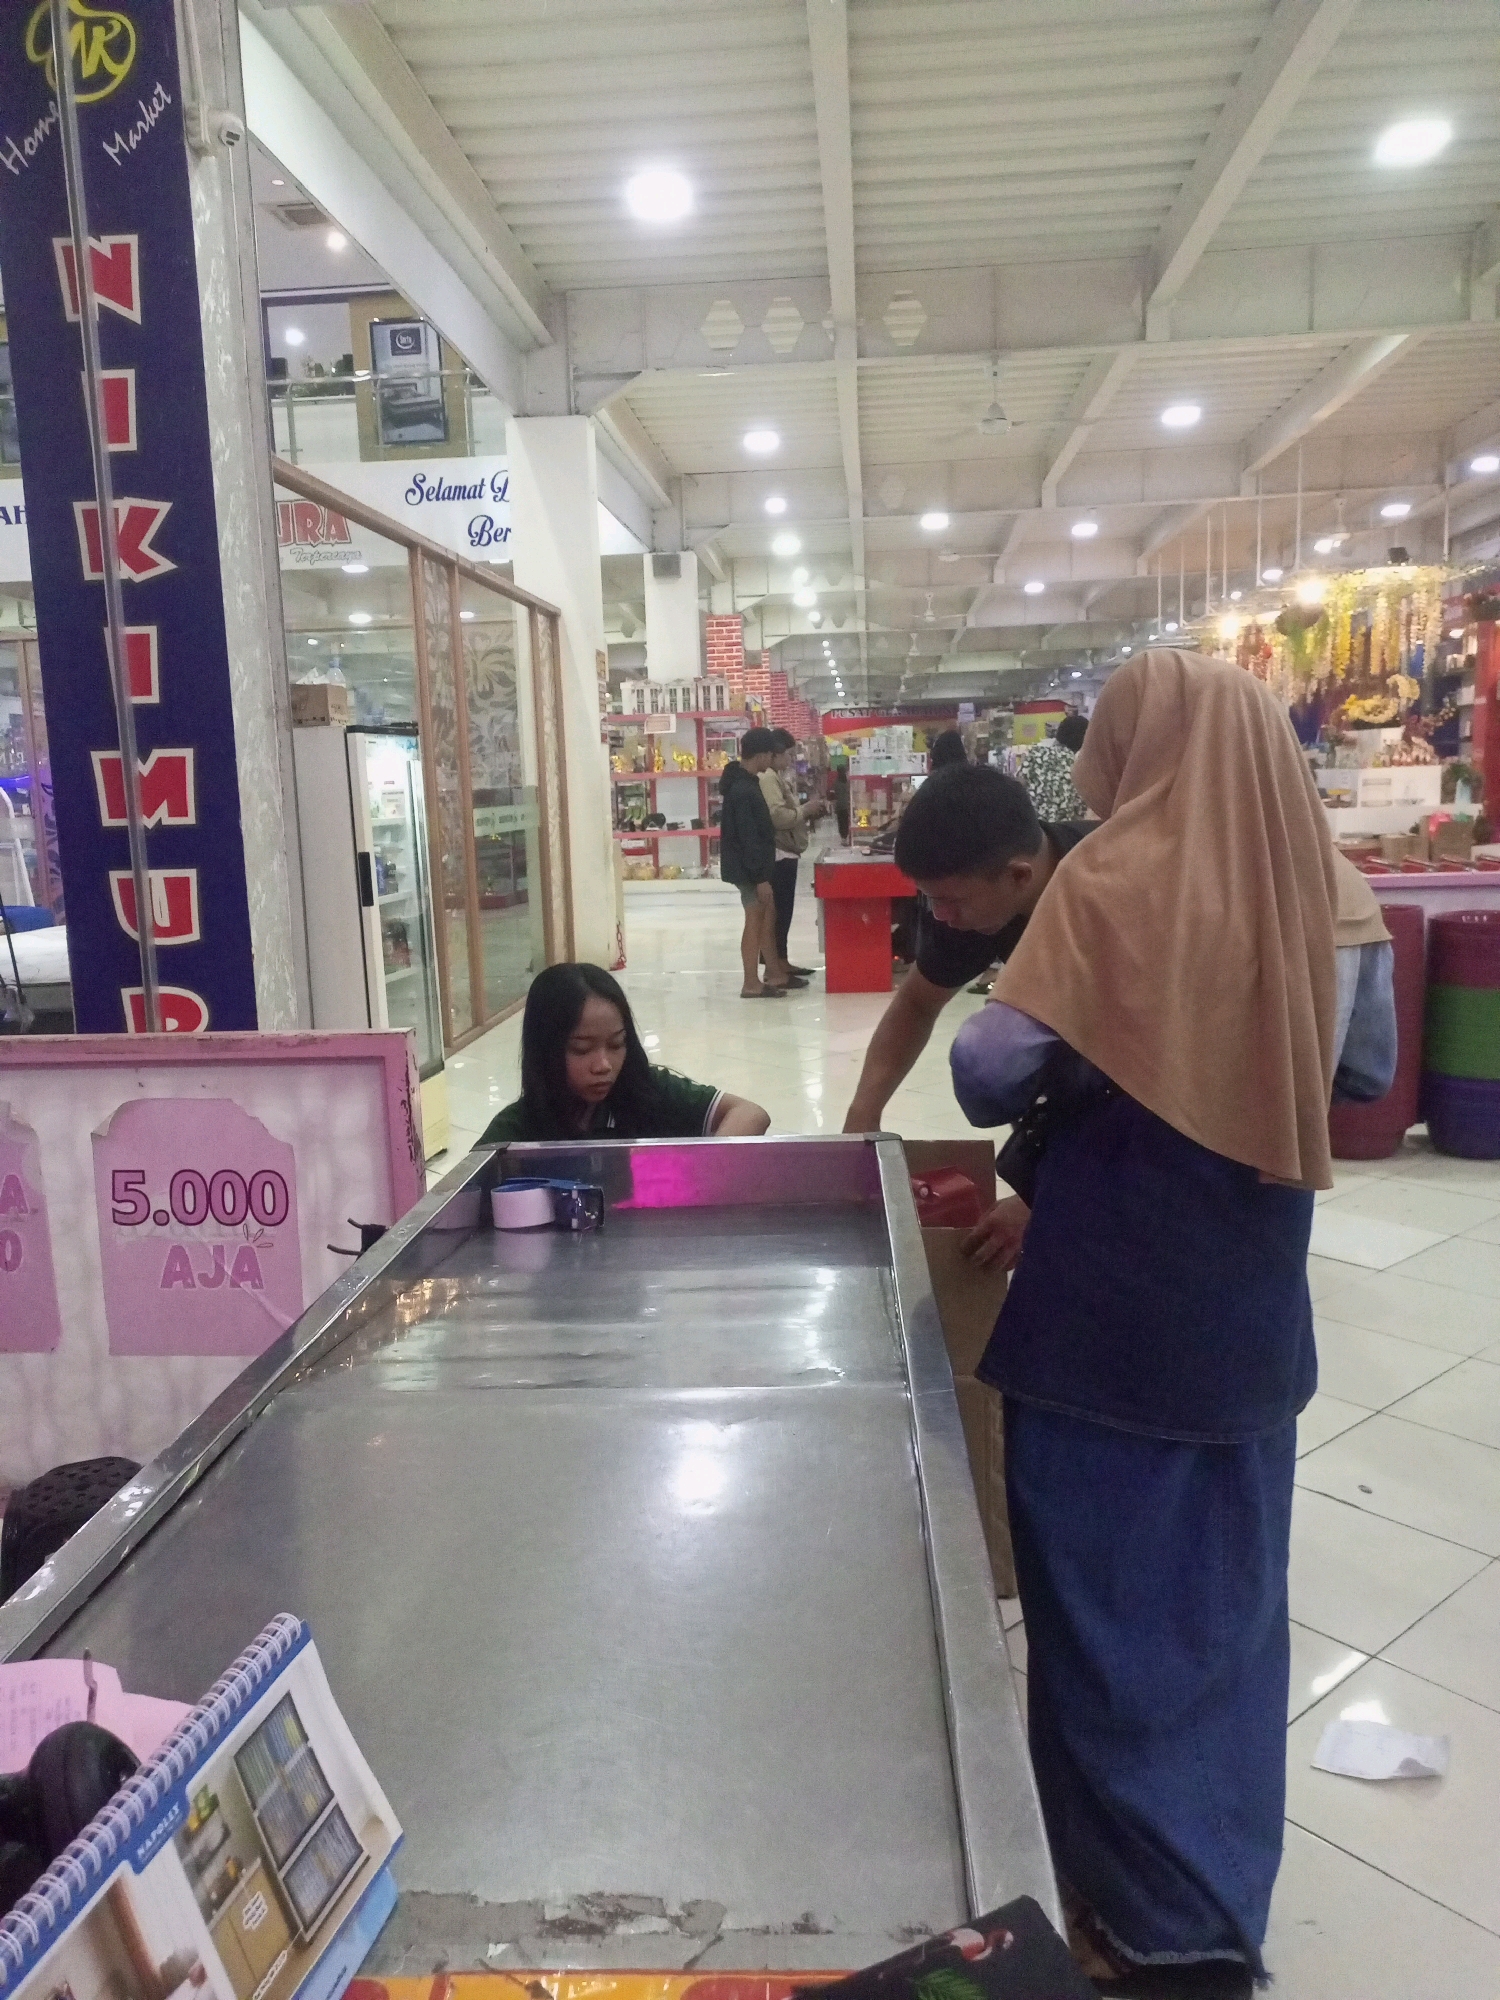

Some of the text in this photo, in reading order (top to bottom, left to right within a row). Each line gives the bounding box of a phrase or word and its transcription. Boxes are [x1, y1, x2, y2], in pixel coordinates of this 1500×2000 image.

[102, 81, 172, 166] Market
[404, 472, 487, 506] Selamat
[111, 1169, 289, 1227] 5.000
[160, 1244, 264, 1289] AJA
